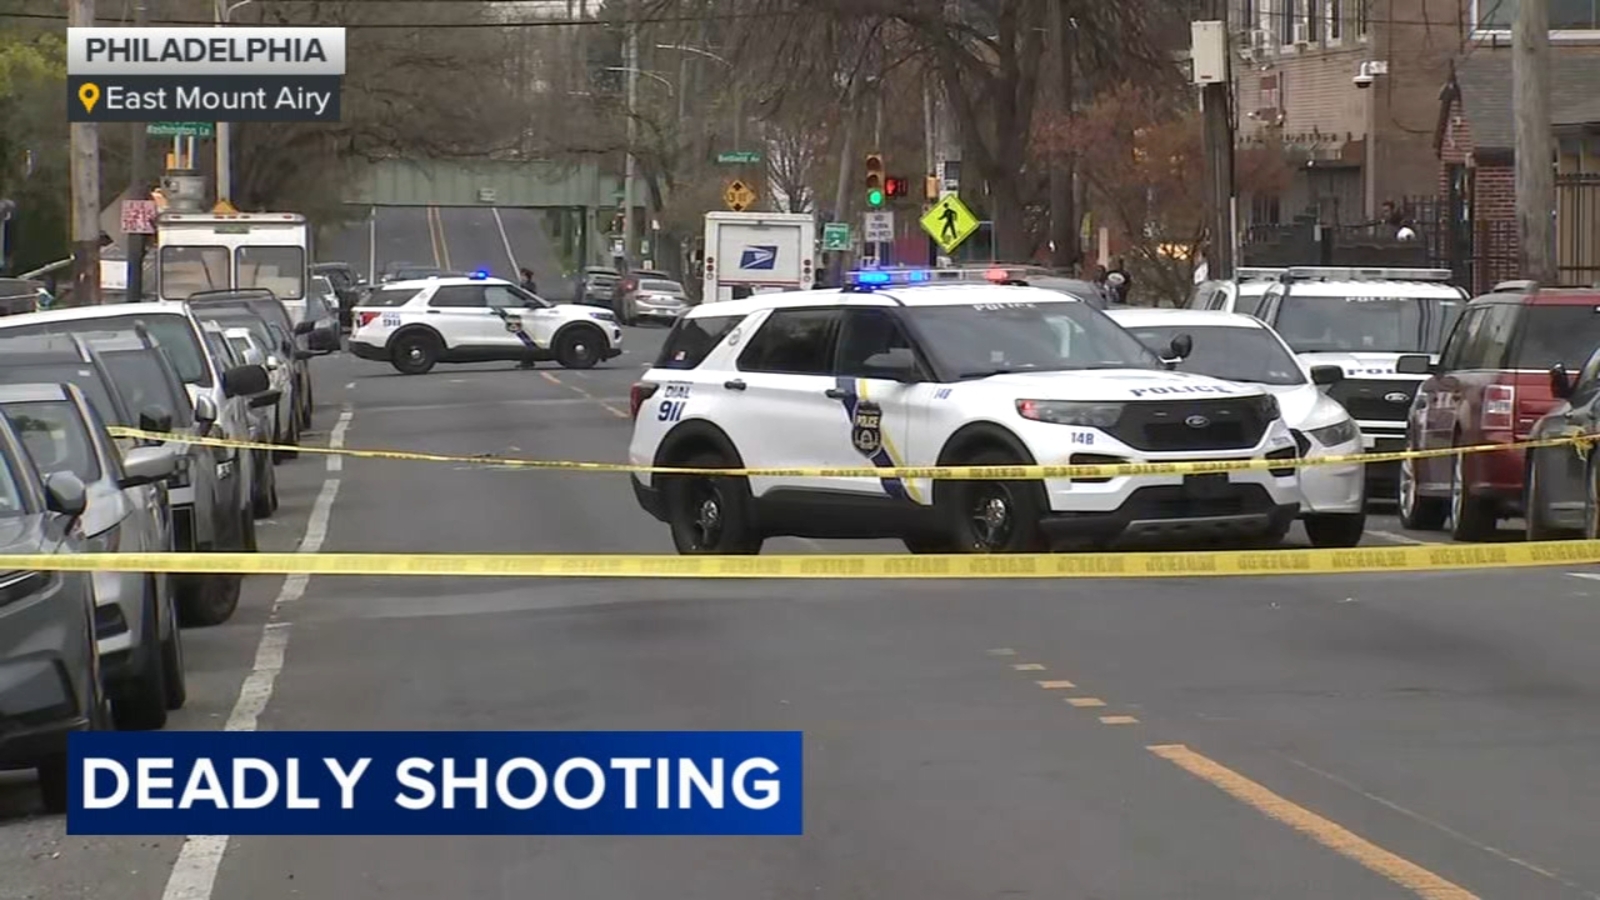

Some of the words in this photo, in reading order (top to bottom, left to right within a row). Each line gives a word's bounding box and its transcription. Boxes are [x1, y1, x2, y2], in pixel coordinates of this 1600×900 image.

[664, 385, 692, 399] DIAL
[1129, 385, 1234, 397] POLICE
[658, 400, 687, 422] 911
[857, 415, 879, 428] POLICE
